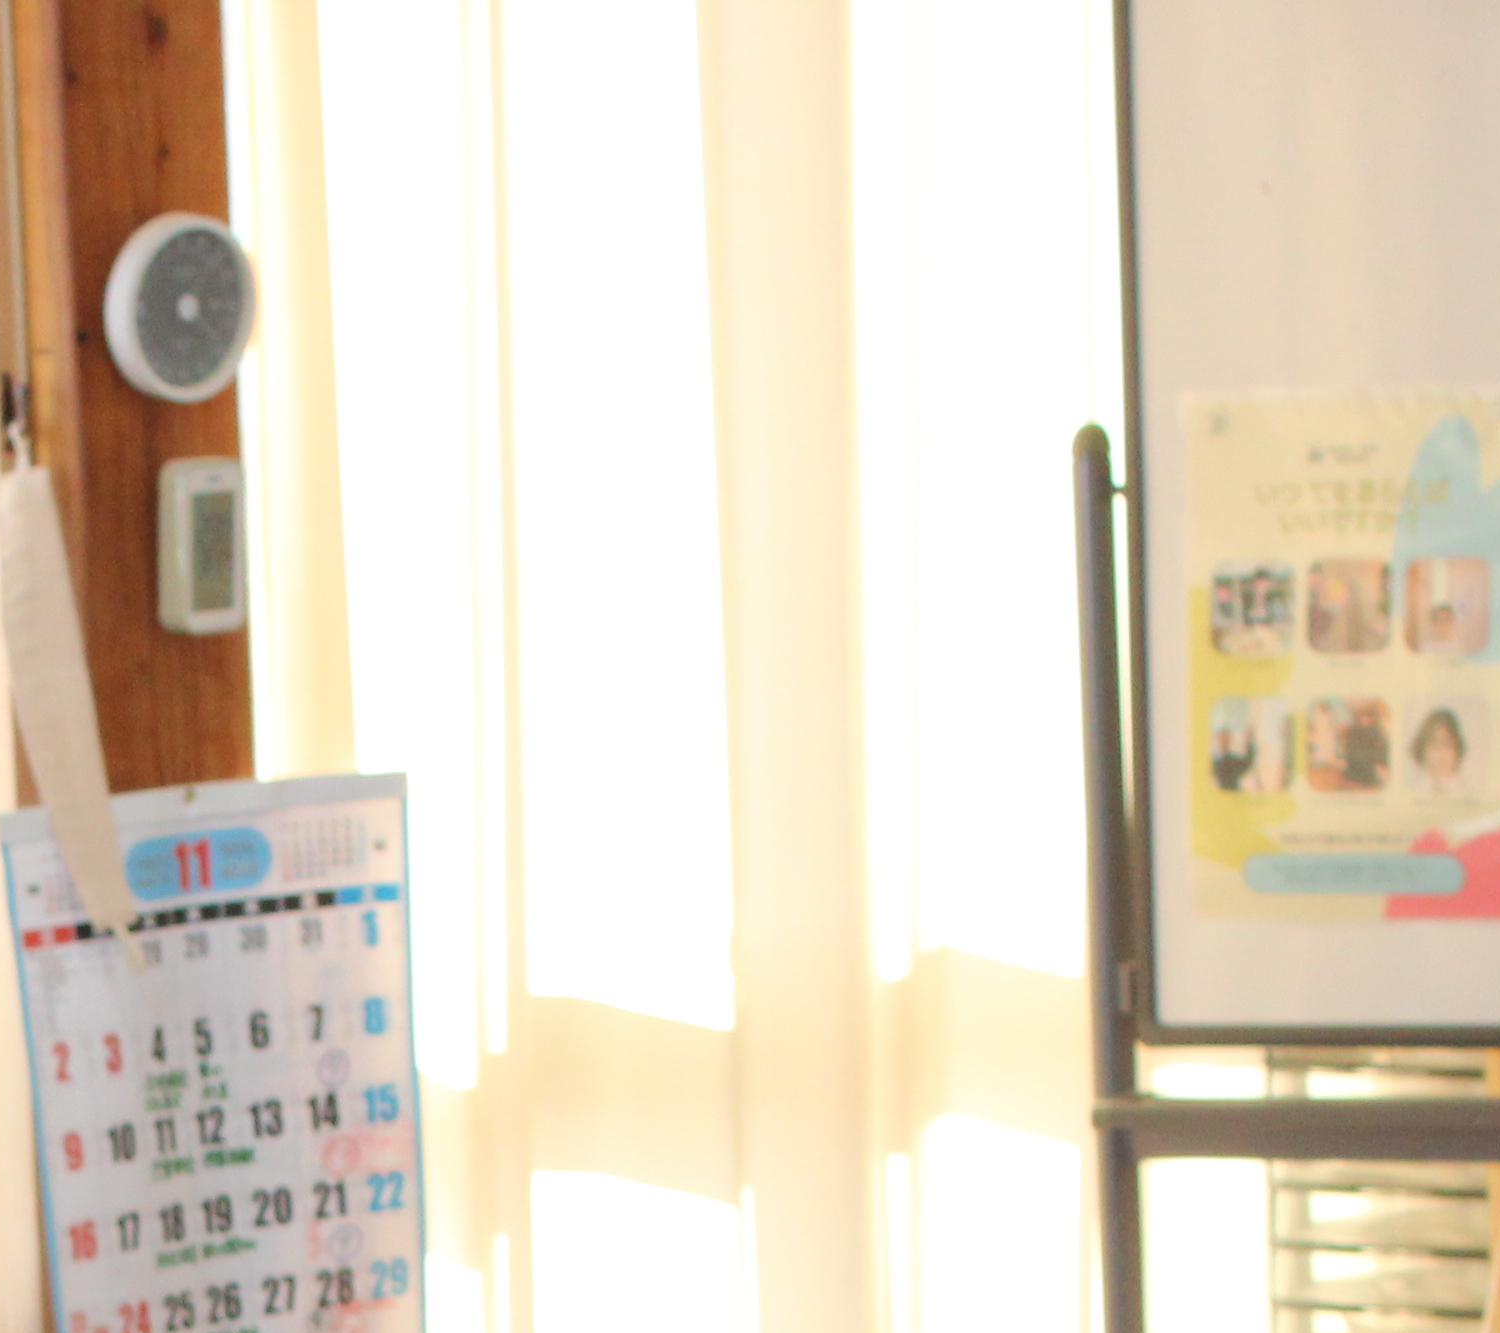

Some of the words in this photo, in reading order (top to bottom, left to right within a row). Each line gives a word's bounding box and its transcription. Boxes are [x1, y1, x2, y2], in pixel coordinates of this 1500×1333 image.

[172, 836, 213, 892] 11
[362, 908, 379, 947] 1
[54, 1041, 72, 1083] 2
[103, 1032, 123, 1075] 3
[153, 1024, 167, 1063] 4
[194, 1016, 213, 1056] 5
[249, 1009, 271, 1050] 6
[308, 1003, 325, 1042] 7
[63, 1130, 84, 1171] 9
[107, 1121, 138, 1162] 10
[154, 1115, 177, 1153] 11
[197, 1104, 226, 1145] 12
[249, 1097, 284, 1139] 13
[308, 1089, 341, 1132] 14
[362, 1082, 400, 1123] 15
[68, 1218, 98, 1262] 16
[115, 1211, 141, 1253] 17
[158, 1202, 186, 1243] 18
[200, 1193, 233, 1234] 19
[251, 1186, 294, 1229] 20
[313, 1179, 348, 1221] 21
[365, 1170, 406, 1213] 22
[162, 1289, 196, 1333] 25
[205, 1281, 243, 1325] 26
[260, 1273, 298, 1316] 27
[316, 1265, 356, 1310] 28
[370, 1255, 410, 1300] 29
